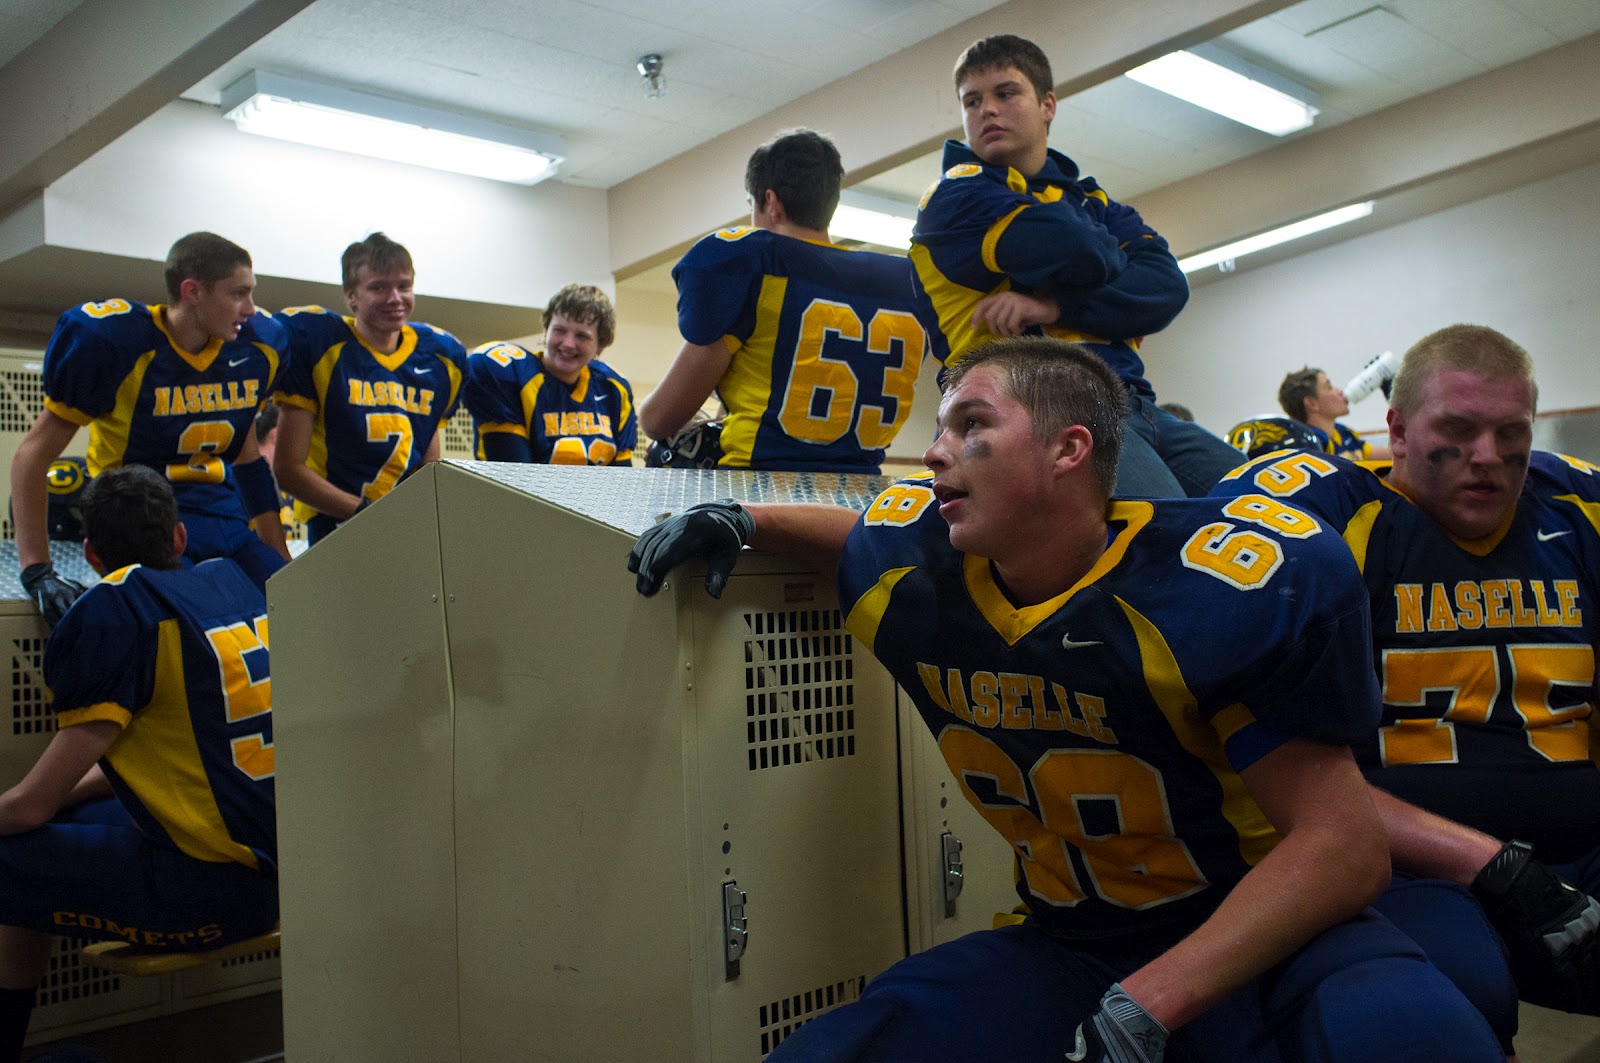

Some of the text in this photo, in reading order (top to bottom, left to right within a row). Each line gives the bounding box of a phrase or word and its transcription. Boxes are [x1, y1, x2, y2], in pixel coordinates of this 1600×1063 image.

[81, 298, 132, 319] 3
[153, 379, 259, 416] NASELLE
[348, 378, 434, 416] NASELLE
[777, 298, 926, 450] 63
[361, 412, 414, 501] 7
[864, 470, 937, 528] 8
[1180, 494, 1323, 591] 68
[1394, 579, 1583, 633] NASELLE
[916, 661, 1120, 744] NASELLE
[1378, 643, 1595, 768] 75
[937, 723, 1210, 910] 68
[51, 910, 223, 946] COMETS
